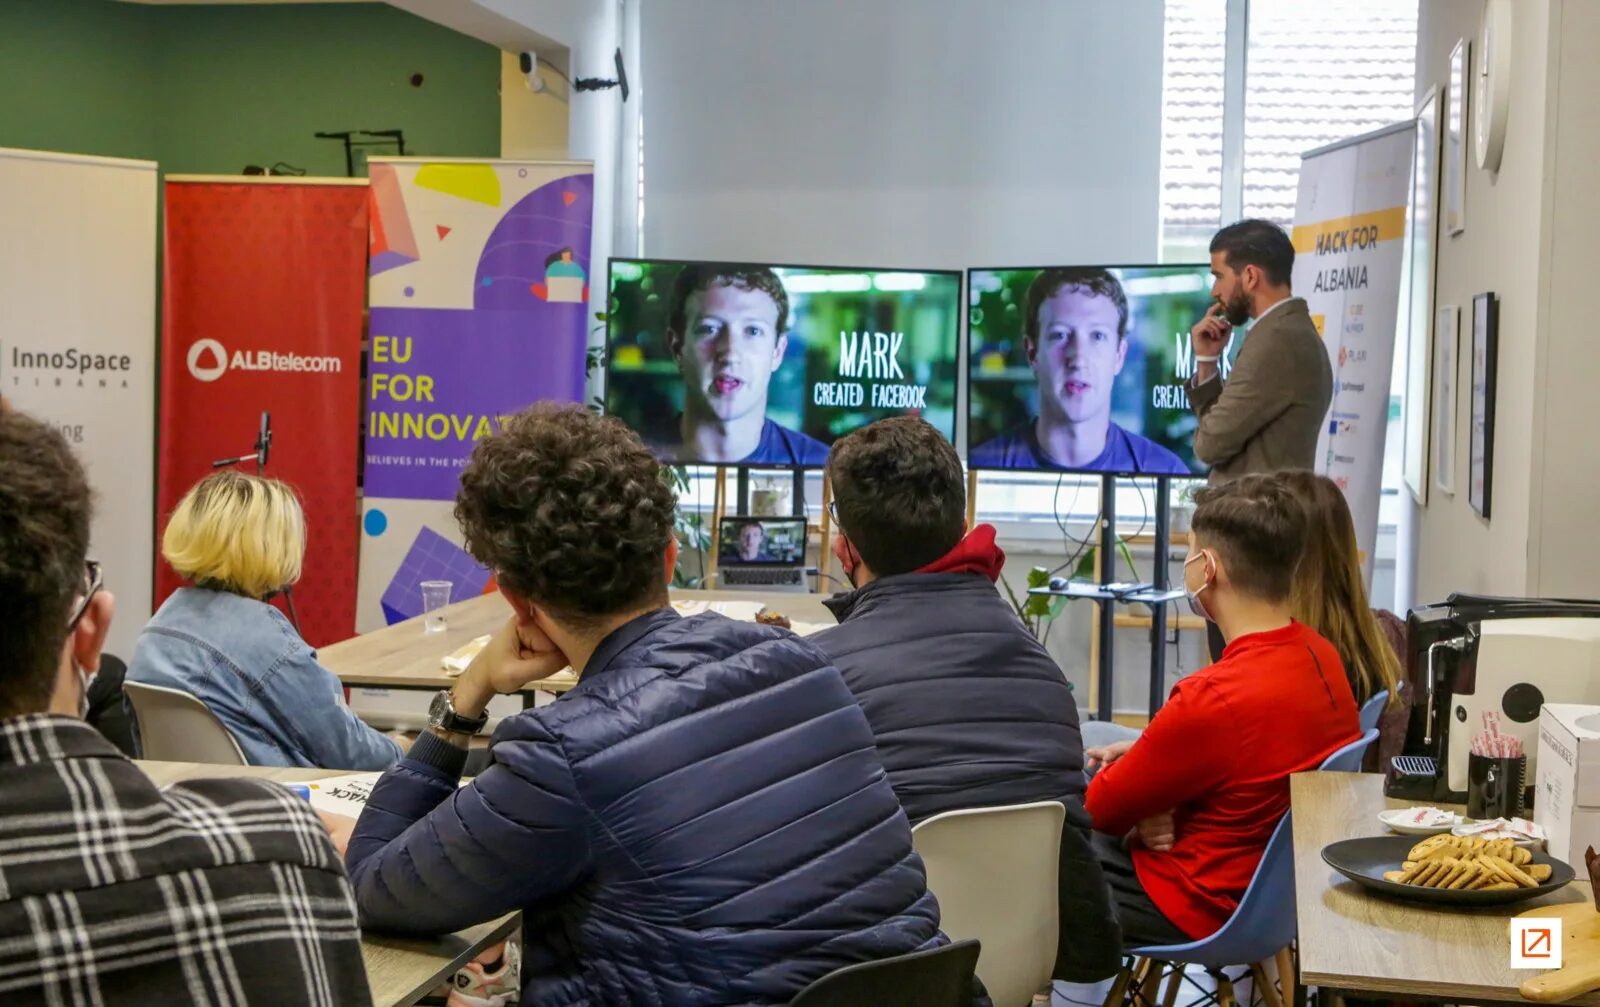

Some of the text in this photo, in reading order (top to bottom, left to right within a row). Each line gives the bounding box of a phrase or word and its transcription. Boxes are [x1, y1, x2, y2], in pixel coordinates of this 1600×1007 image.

[1315, 225, 1379, 256] HACK FOR
[1313, 265, 1369, 293] ALBANIA
[13, 346, 131, 375] InnoSpace
[229, 350, 342, 373] ALBtelecom
[372, 335, 413, 364] EU
[838, 331, 904, 380] MARK
[1175, 332, 1235, 380] MK
[13, 376, 129, 388] TIRANA
[371, 373, 435, 402] FOR
[813, 382, 927, 409] CREATED FACEBOOK
[1152, 384, 1191, 409] CREAT
[366, 455, 412, 465] BELIEVES
[415, 457, 426, 466] IN
[429, 457, 449, 467] THE
